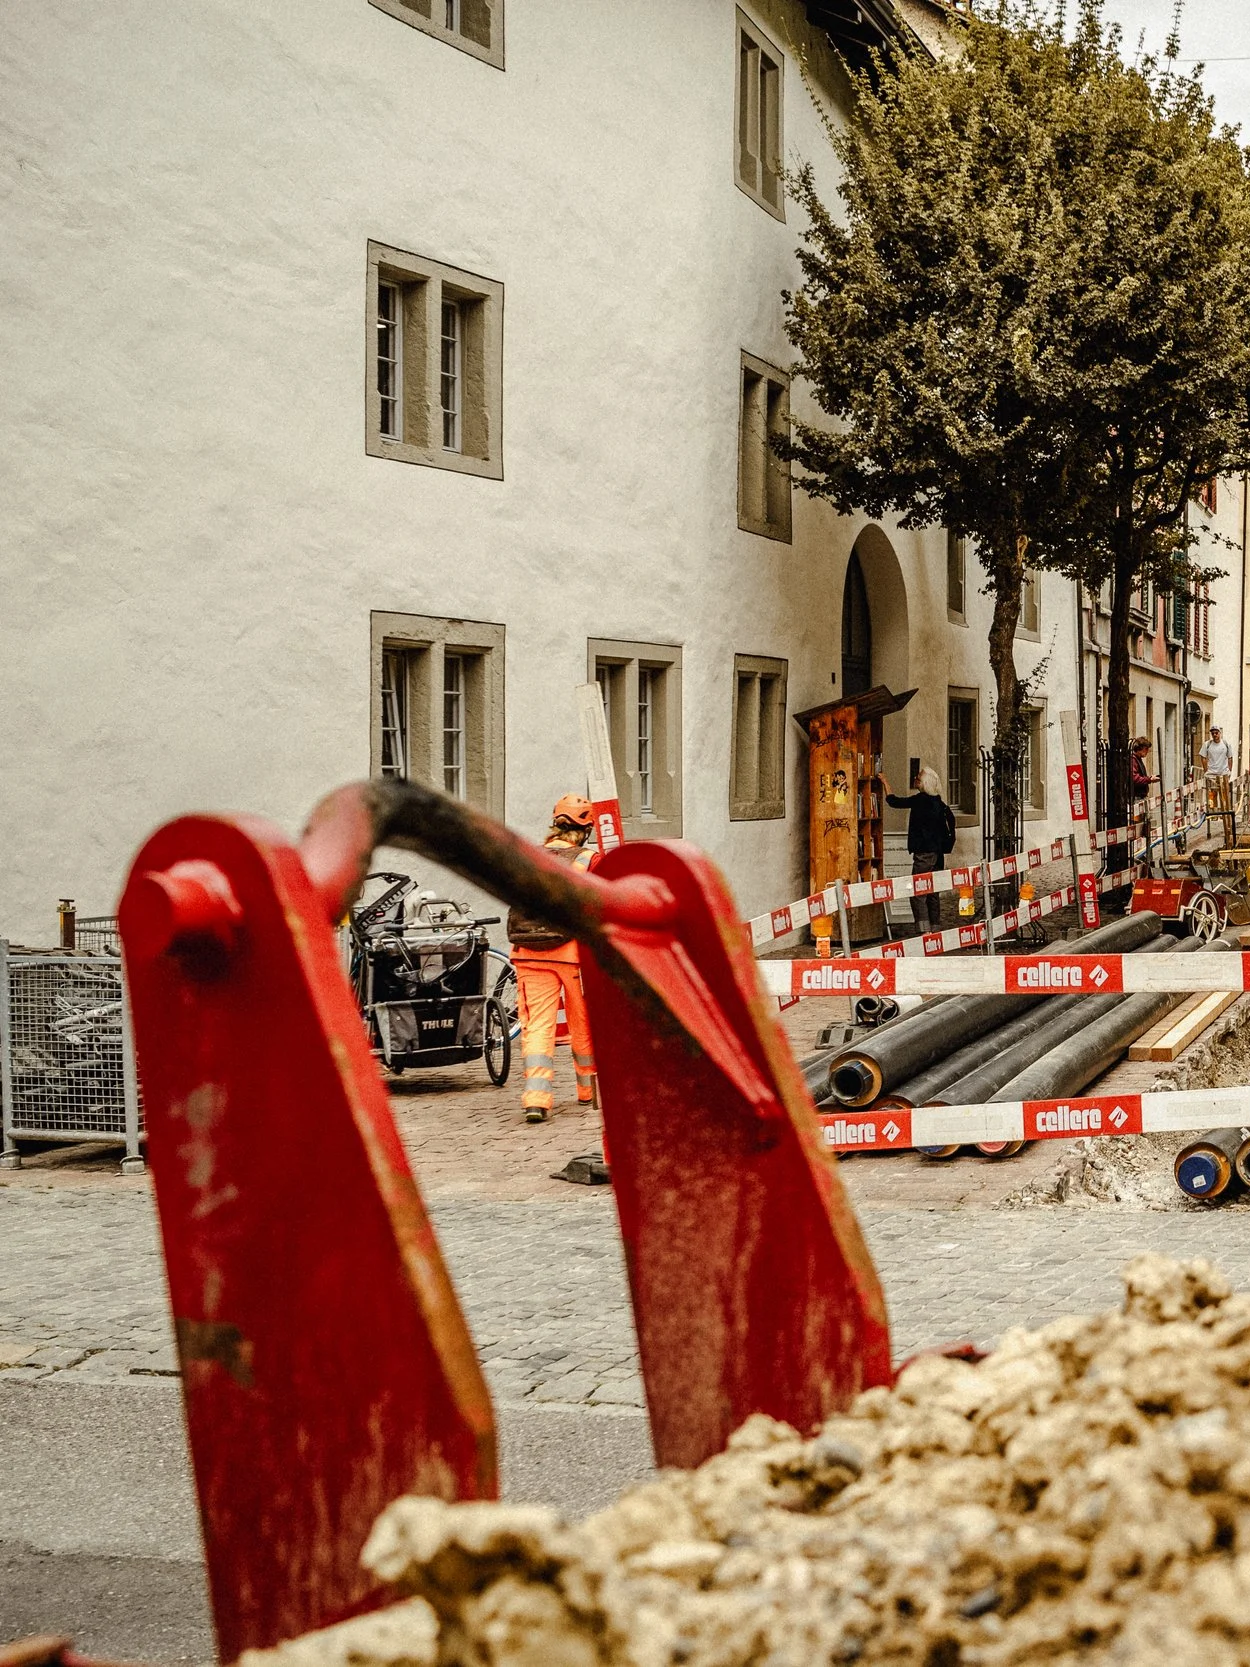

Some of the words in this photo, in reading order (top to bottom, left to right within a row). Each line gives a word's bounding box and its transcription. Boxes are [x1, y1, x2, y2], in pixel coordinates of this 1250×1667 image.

[1072, 783, 1084, 816] cellere
[802, 965, 861, 990] cellere
[1017, 962, 1082, 987] cellere
[422, 1018, 454, 1030] THULE
[1036, 1105, 1101, 1132] cellere
